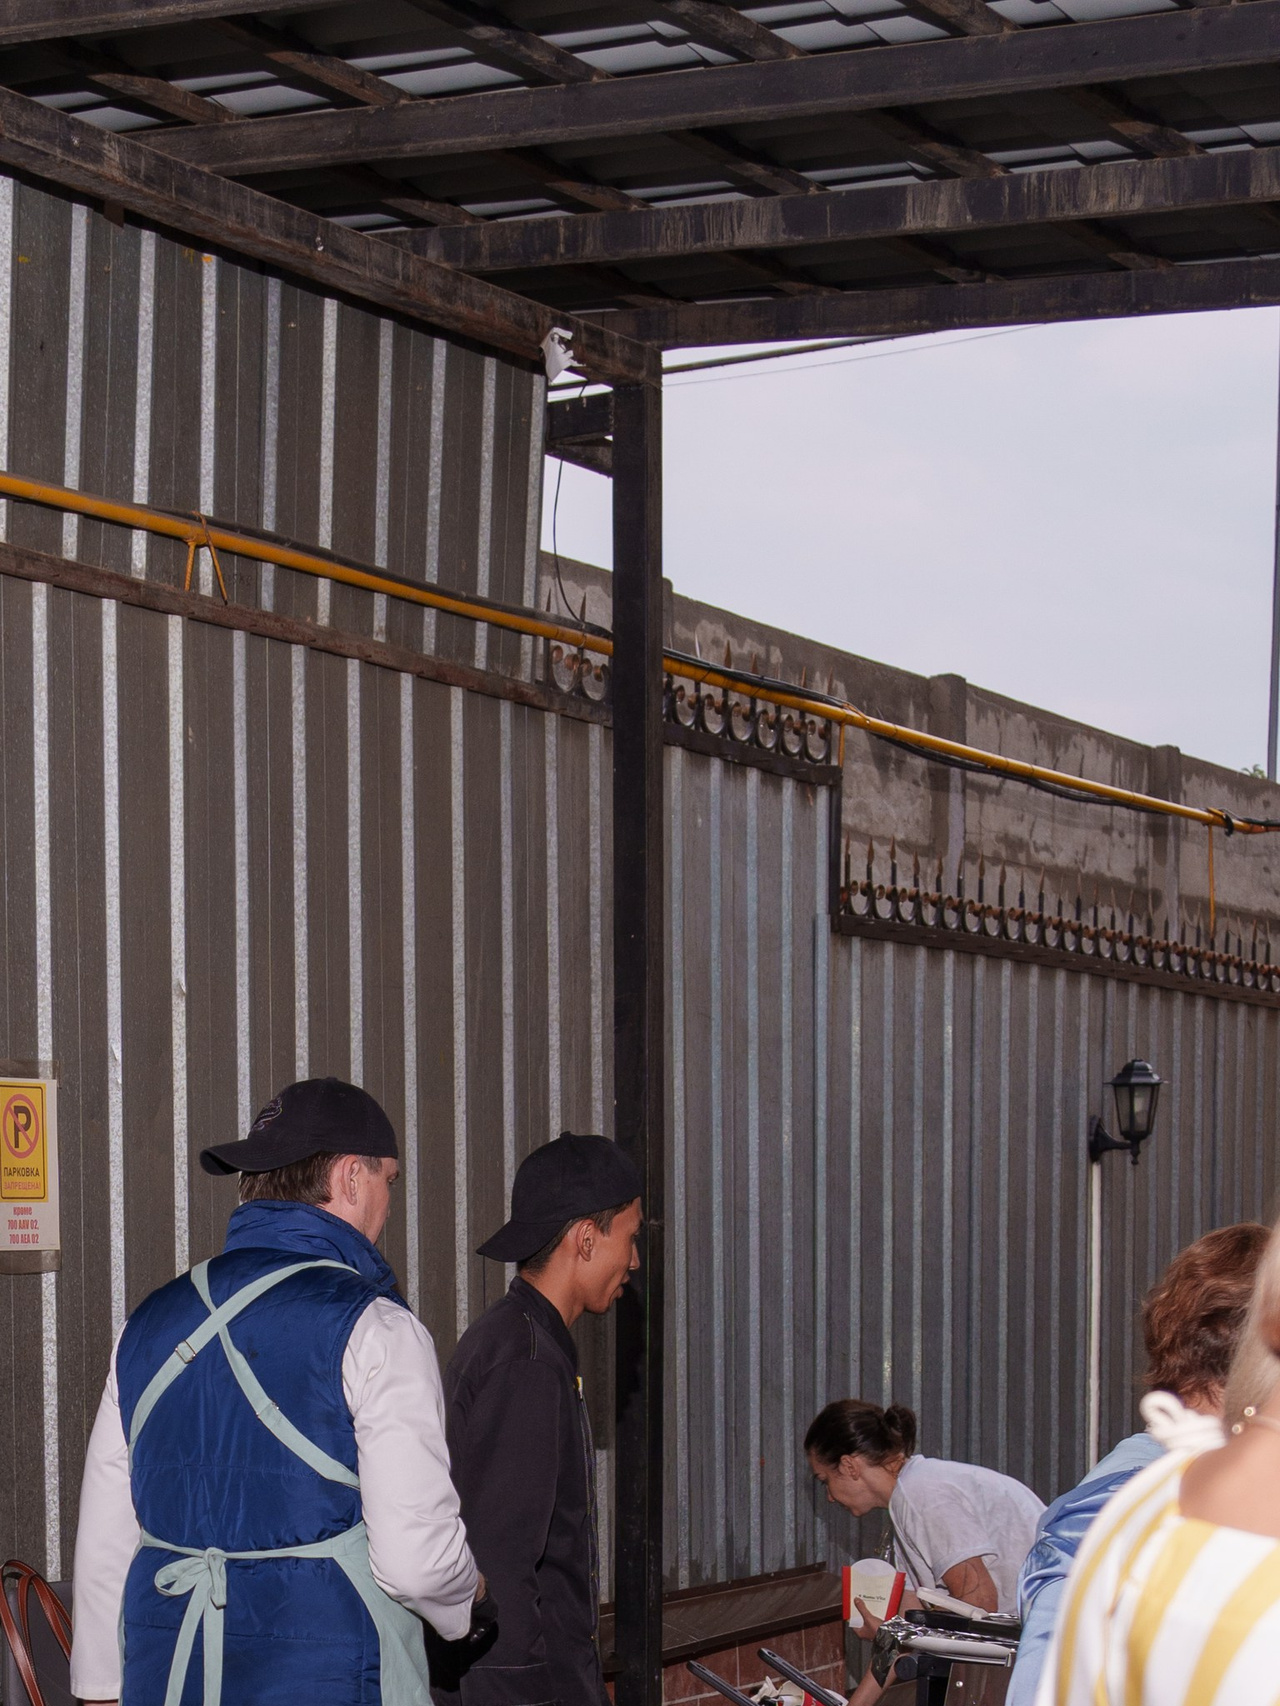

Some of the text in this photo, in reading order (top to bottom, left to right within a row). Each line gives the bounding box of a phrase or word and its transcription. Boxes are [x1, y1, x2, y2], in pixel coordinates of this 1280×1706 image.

[3, 1166, 40, 1177] ПАРКОВКА
[3, 1180, 41, 1191] ЗАПРЕЩЕНА!
[13, 1206, 33, 1216] кроме
